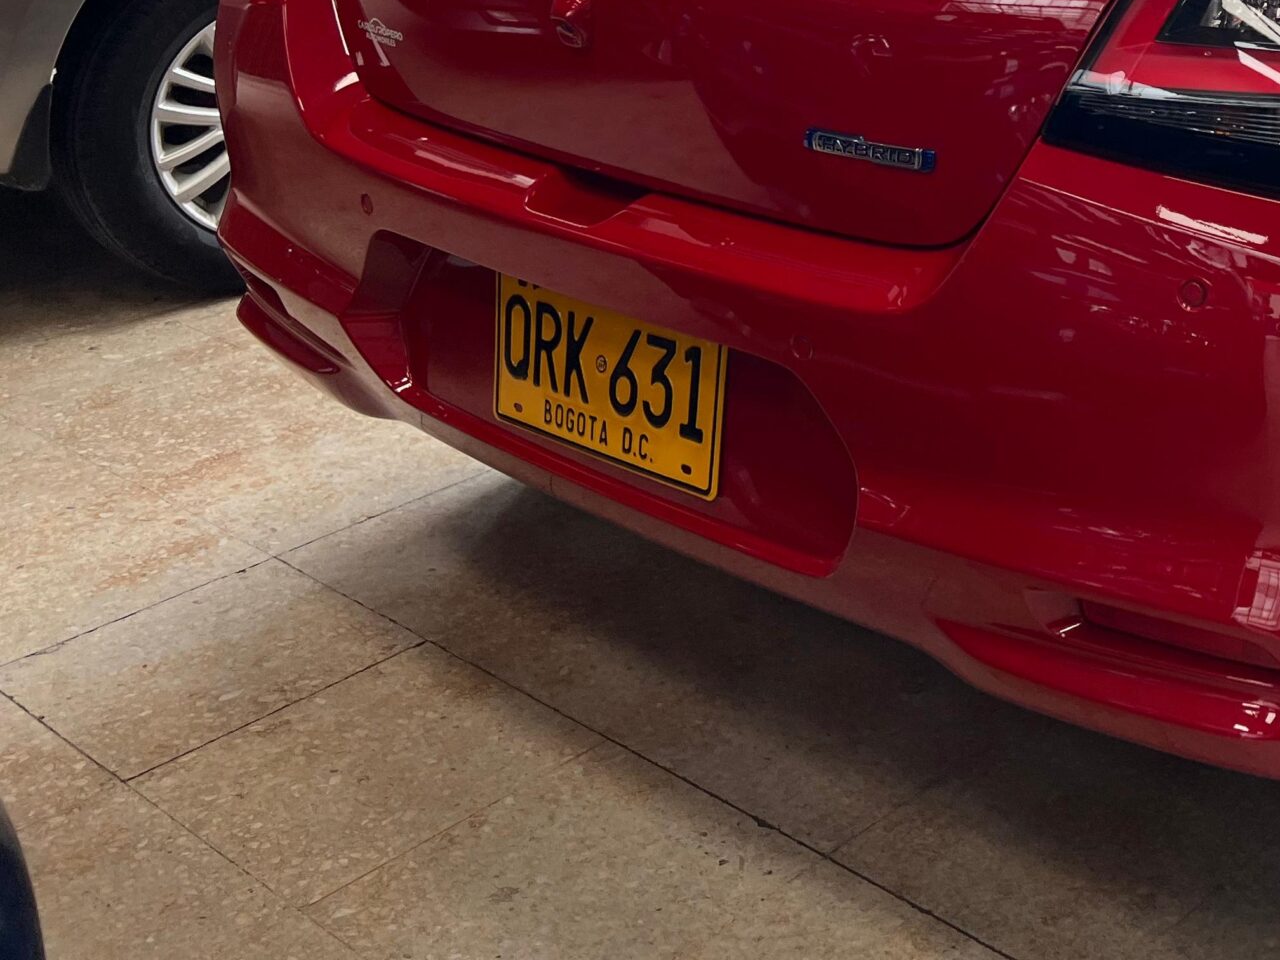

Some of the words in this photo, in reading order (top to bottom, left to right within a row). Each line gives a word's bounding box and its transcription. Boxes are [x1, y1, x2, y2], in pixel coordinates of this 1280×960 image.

[819, 137, 913, 165] HYBRID
[504, 293, 594, 405] QRK
[608, 328, 704, 445] 631
[543, 399, 609, 447] BOGOTA
[621, 427, 654, 464] D.C.
